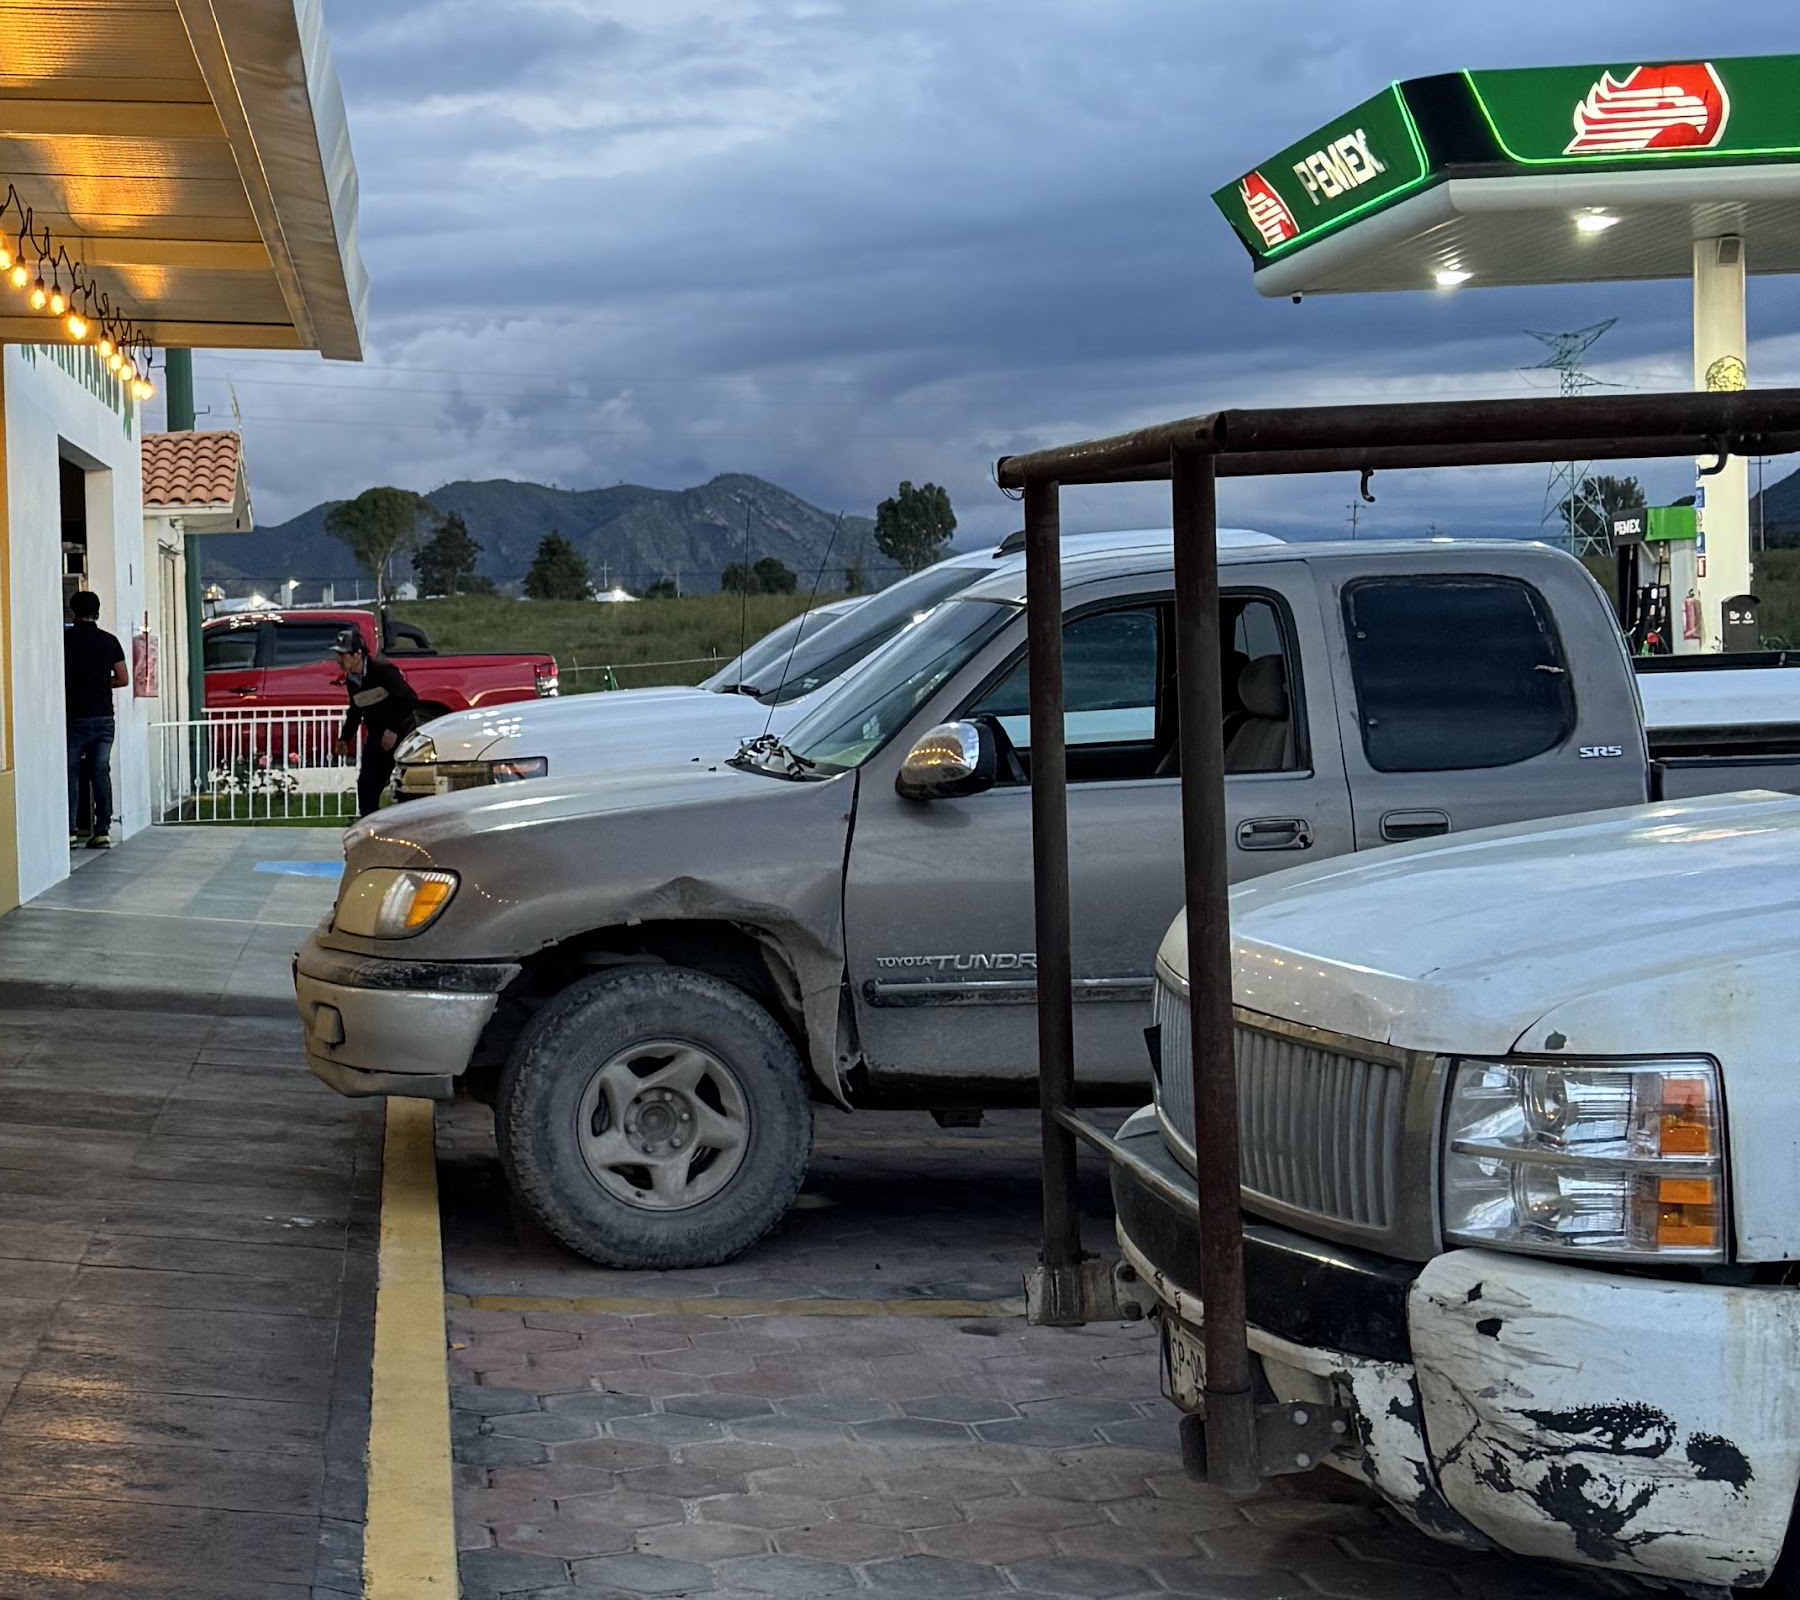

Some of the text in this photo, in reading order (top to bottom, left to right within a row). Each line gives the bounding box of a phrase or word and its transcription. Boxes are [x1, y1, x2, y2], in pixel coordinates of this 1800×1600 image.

[1292, 128, 1386, 206] PEMEX
[1613, 518, 1641, 537] PEMEX
[877, 953, 1037, 970] TOYOTA TUNDR
